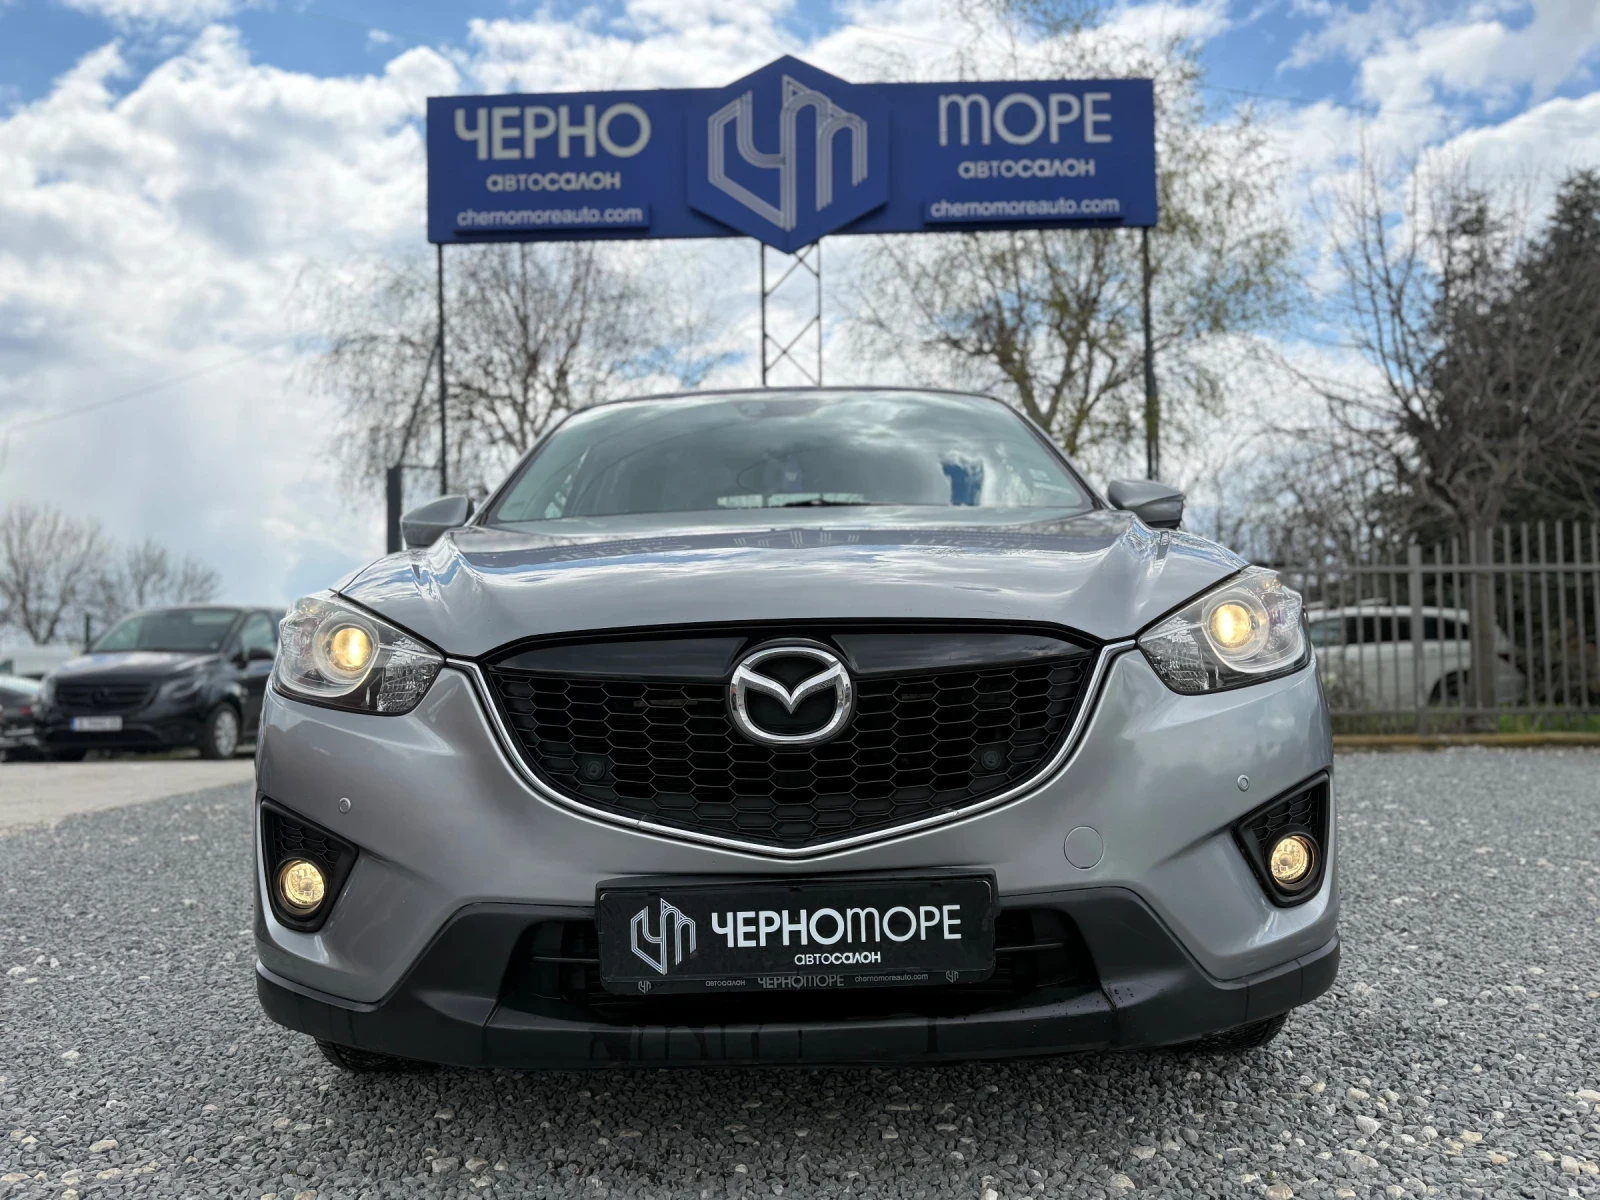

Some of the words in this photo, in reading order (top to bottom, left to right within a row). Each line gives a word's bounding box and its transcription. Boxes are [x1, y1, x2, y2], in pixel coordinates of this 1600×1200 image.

[454, 103, 651, 160] ЧЕРНО
[457, 207, 643, 226] chernomoreauto.com
[931, 198, 1120, 217] chernomoreauto.com
[711, 904, 962, 948] ЧЕРНОМОРЕ
[794, 952, 881, 965] автосалон
[854, 973, 929, 982] chernomoreauto.com
